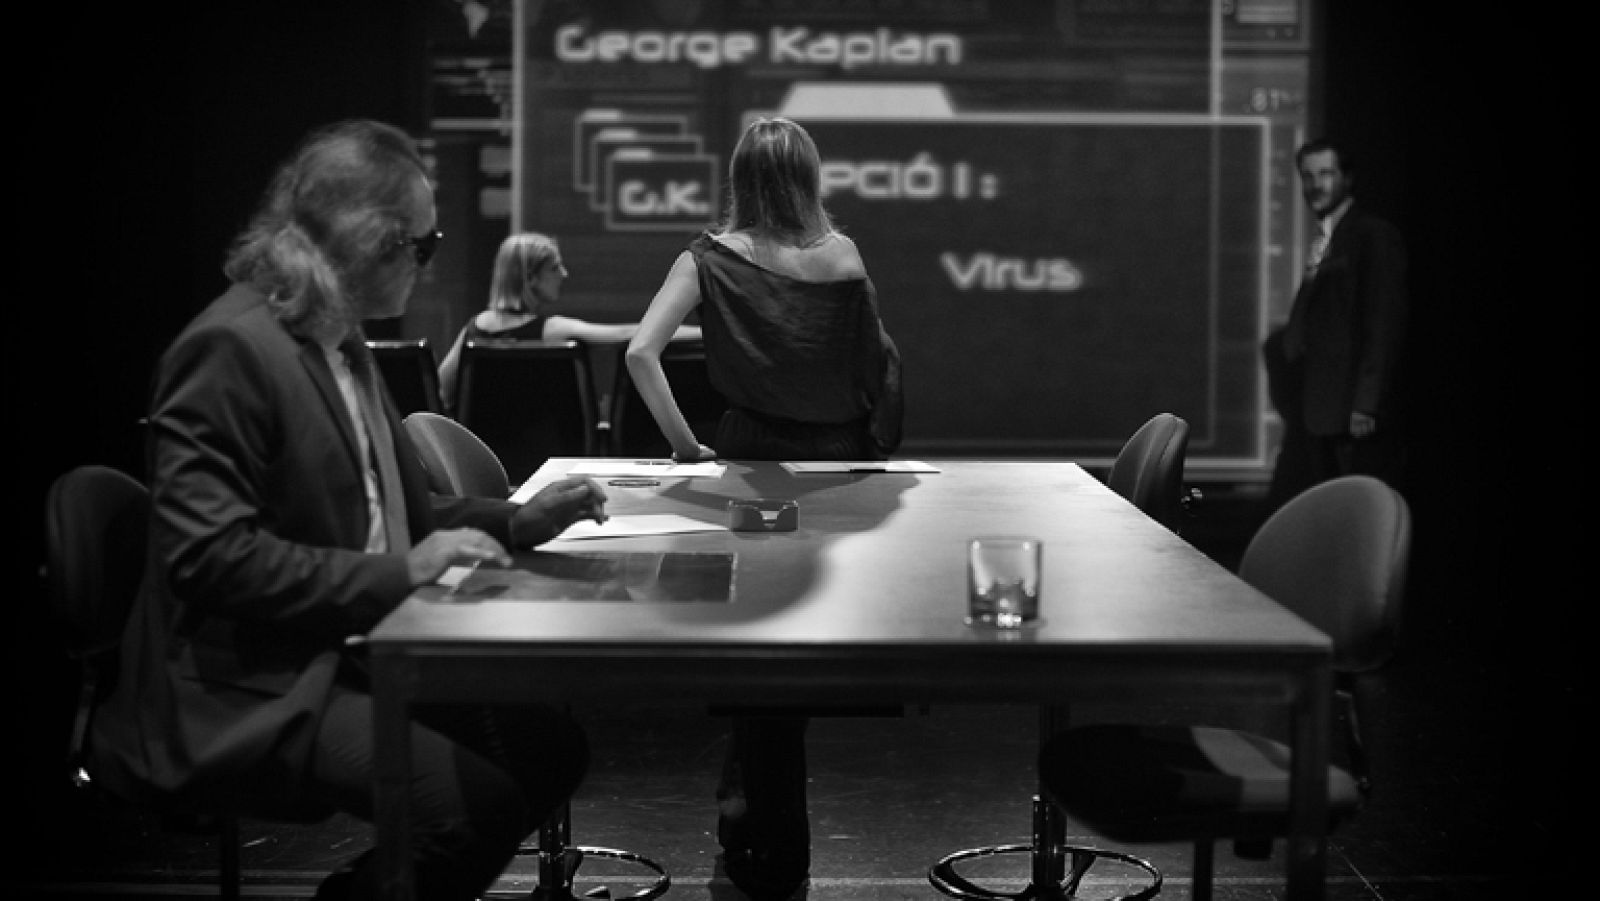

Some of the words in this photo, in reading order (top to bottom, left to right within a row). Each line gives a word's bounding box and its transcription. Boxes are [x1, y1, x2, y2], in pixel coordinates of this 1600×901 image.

[556, 25, 759, 68] George
[770, 26, 962, 69] Kaplan
[820, 152, 943, 198] PCIÓ
[619, 181, 711, 215] G.K.
